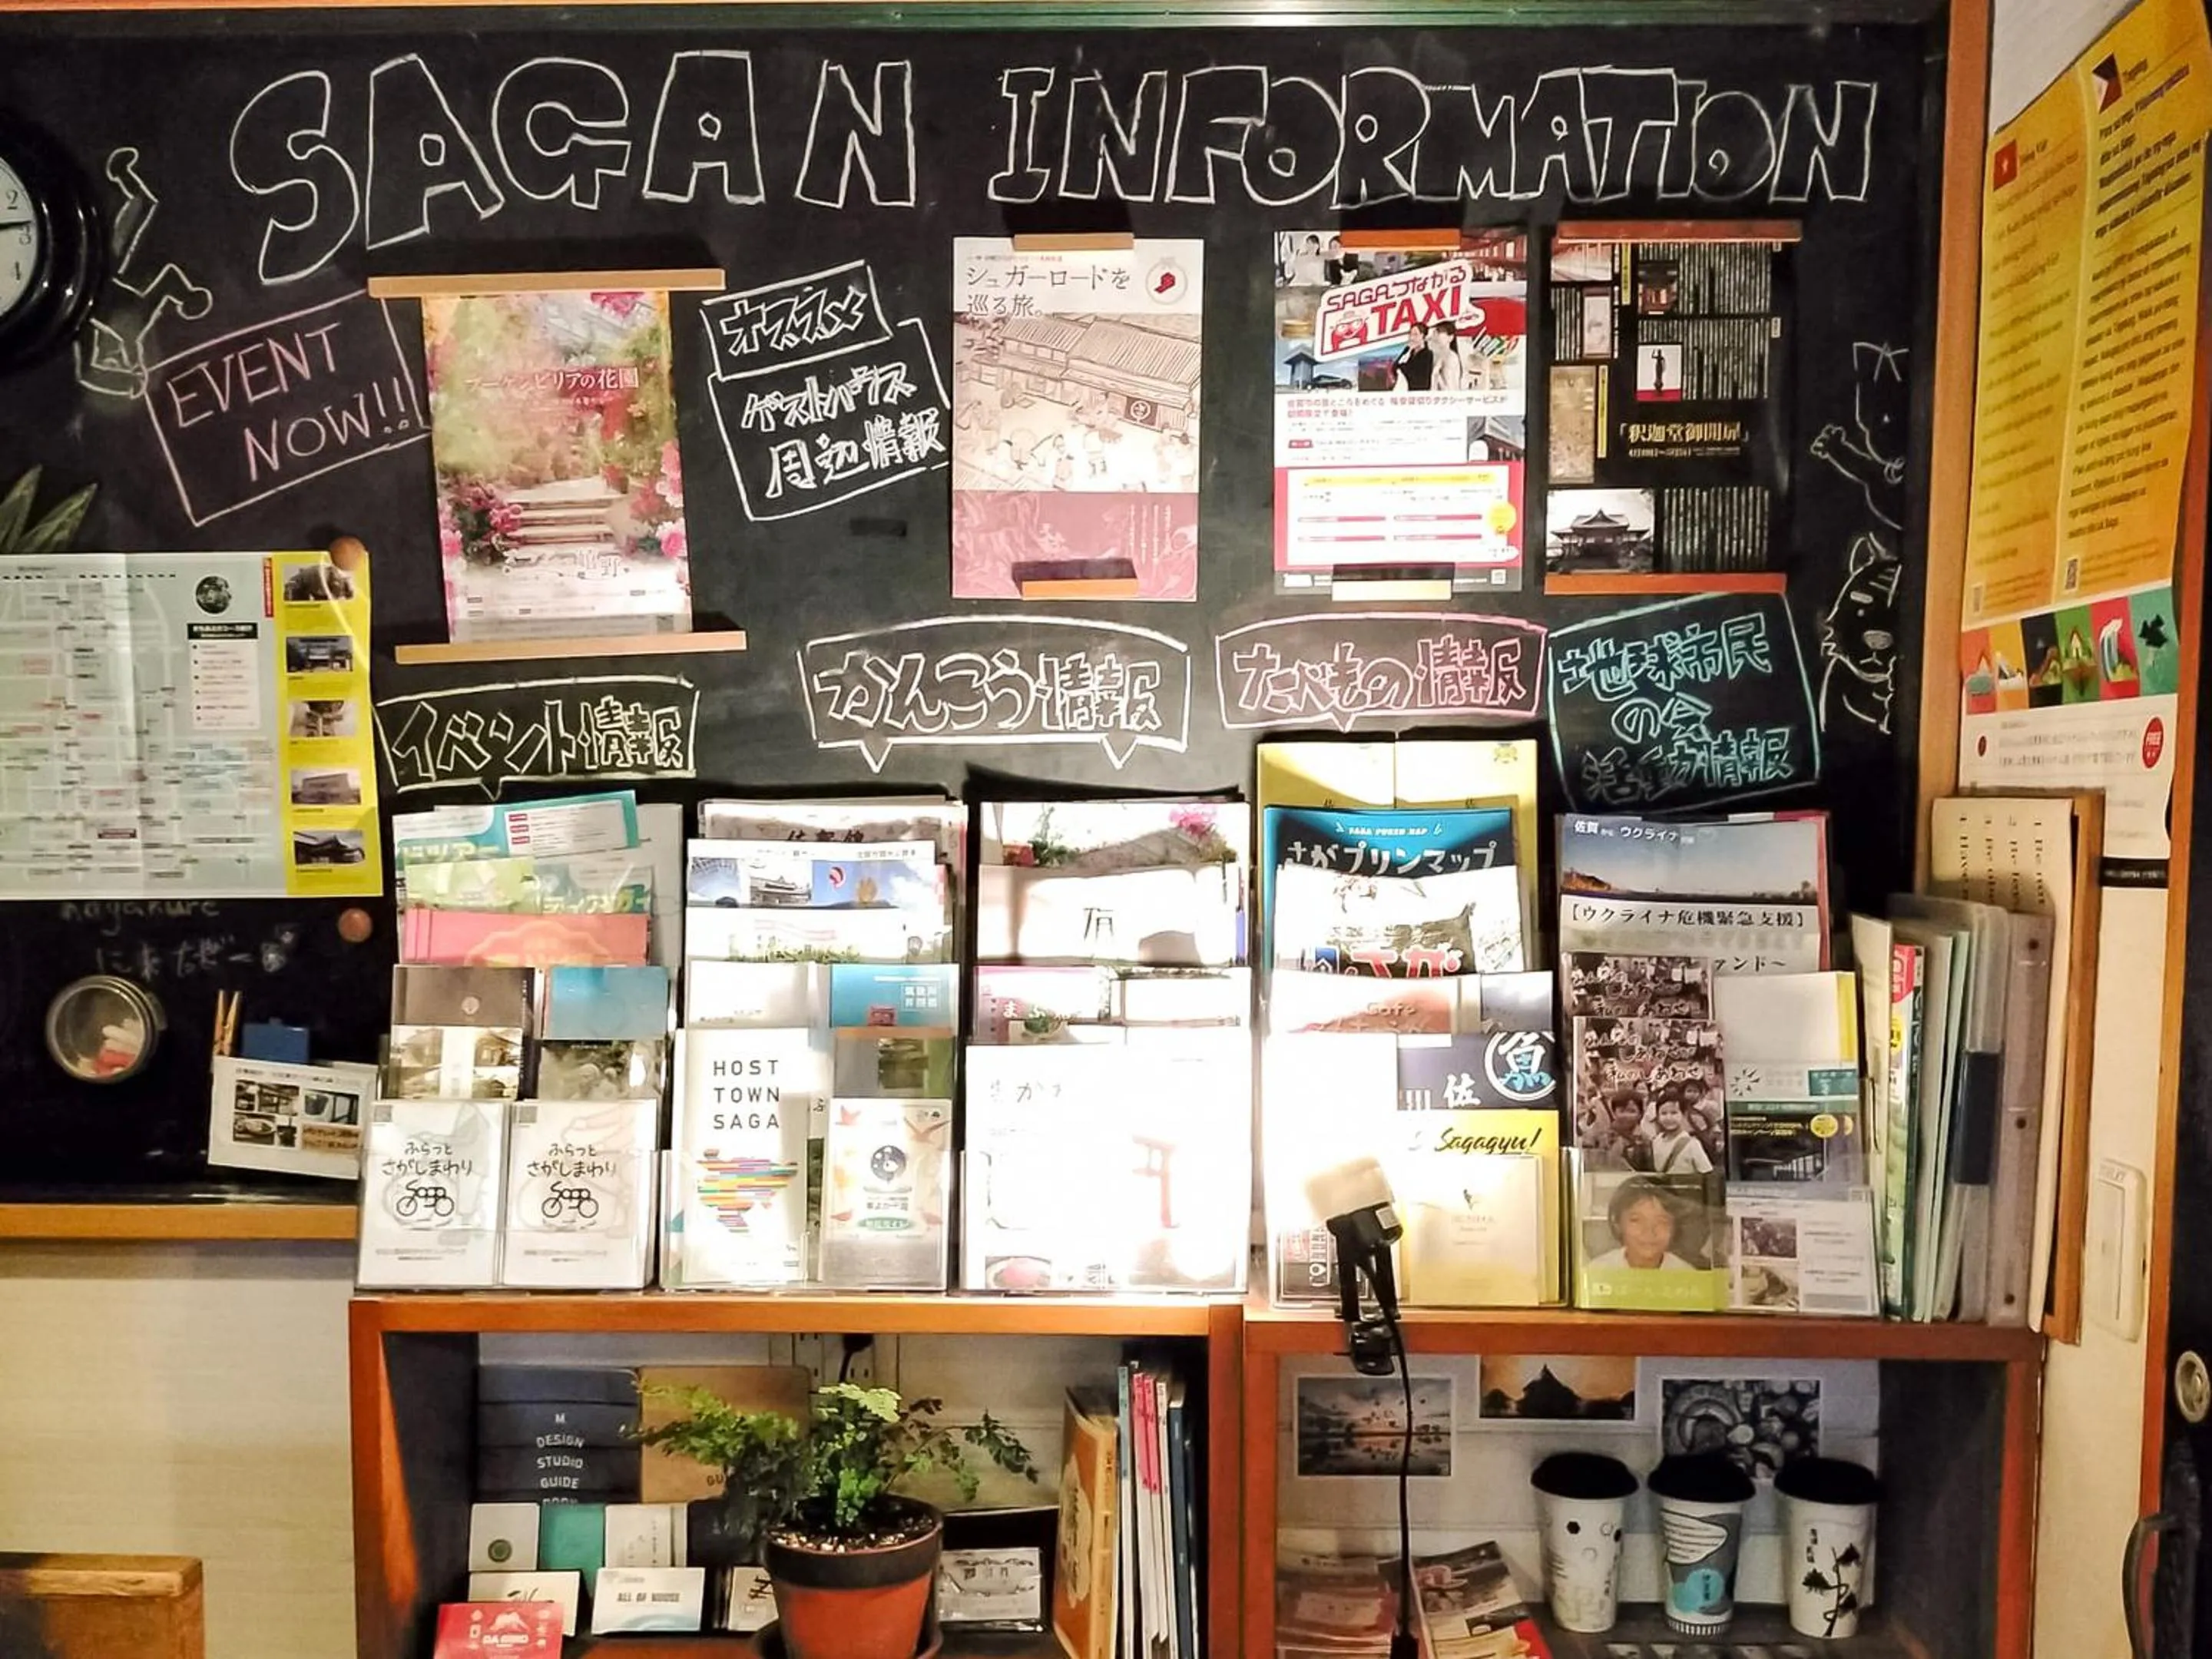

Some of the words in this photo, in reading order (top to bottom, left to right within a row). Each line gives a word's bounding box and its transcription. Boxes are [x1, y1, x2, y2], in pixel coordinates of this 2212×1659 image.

[230, 52, 916, 284] SAGAN
[988, 65, 1878, 208] INFORMATION
[967, 264, 1131, 290] シュガーロードを
[968, 293, 1043, 317] 巡る旅。
[1371, 283, 1462, 335] TAXI
[720, 286, 866, 356] オススメ
[167, 323, 340, 427] EVENT
[243, 376, 409, 482] NOW!!
[766, 406, 945, 498] 周辺情報
[1558, 613, 1773, 697] 地球市民
[1232, 634, 1528, 713] たべもの情報
[814, 649, 1162, 733] かんこう情報
[1611, 694, 1715, 744] の会
[392, 695, 684, 781] イベント情報
[1582, 726, 1795, 798] 活動情報
[1575, 820, 1599, 835] 佐賀
[1620, 825, 1679, 842] ウクライナ
[1573, 905, 1804, 928] 【ウクライナ危機緊急支援】
[714, 1059, 779, 1076] HOST
[714, 1087, 780, 1103] TOWN
[714, 1114, 780, 1130] SAGA
[404, 1141, 453, 1157] ふらっと
[548, 1142, 597, 1157] ふらっと
[1434, 1128, 1542, 1154] Sagagyu!
[381, 1158, 473, 1177] さがしまわり
[526, 1159, 617, 1178] さがしまわり
[555, 1412, 565, 1423] M
[536, 1434, 584, 1449] DESIGN
[537, 1455, 584, 1469] STUDIO
[540, 1477, 580, 1488] GUIDE
